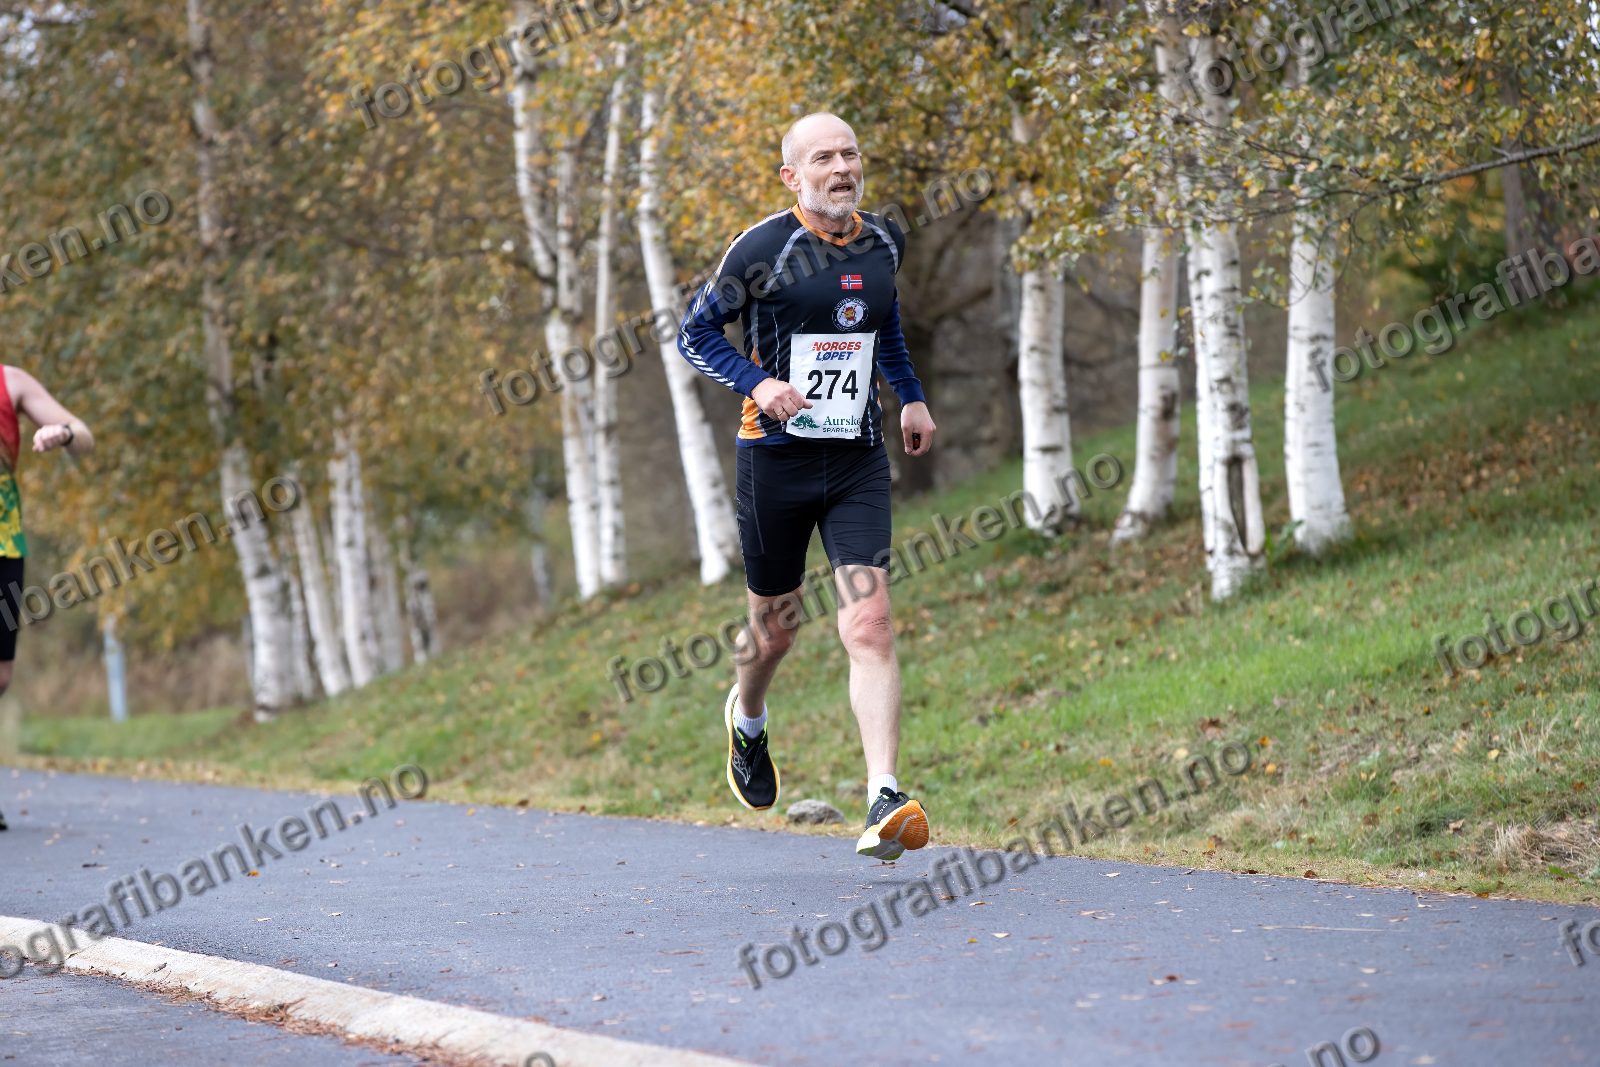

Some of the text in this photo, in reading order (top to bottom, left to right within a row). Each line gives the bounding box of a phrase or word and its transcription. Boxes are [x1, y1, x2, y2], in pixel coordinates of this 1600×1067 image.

[812, 341, 862, 351] NORGES
[815, 351, 853, 361] LØPET
[806, 369, 859, 400] 274
